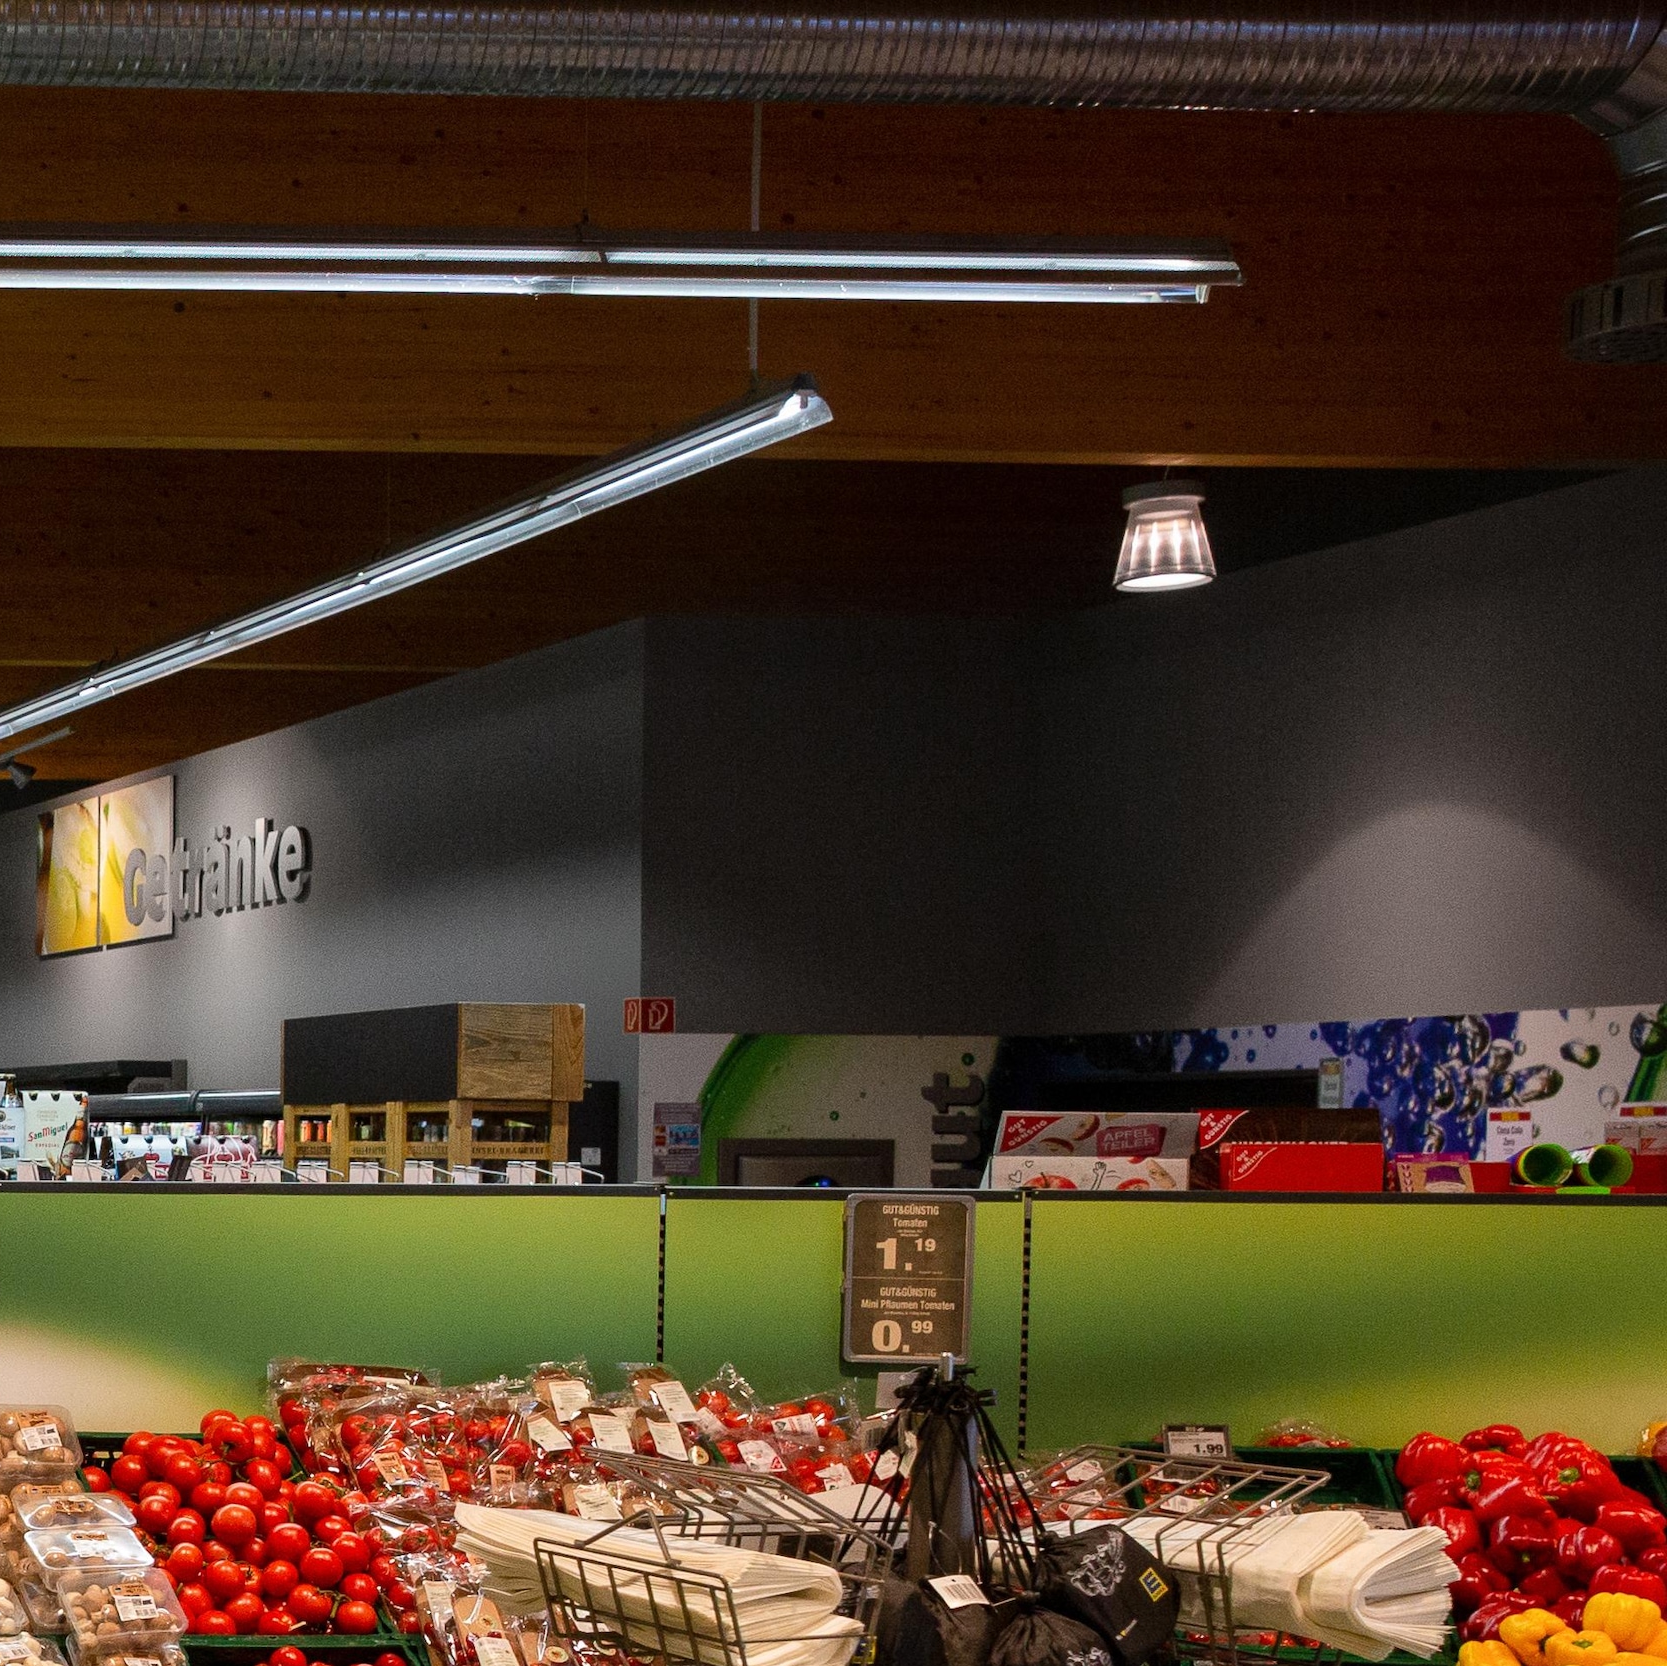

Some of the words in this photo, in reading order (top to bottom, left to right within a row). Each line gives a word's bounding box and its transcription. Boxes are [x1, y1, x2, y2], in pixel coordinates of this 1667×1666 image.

[123, 817, 313, 926] Getränke
[1008, 1117, 1026, 1133] GUT
[1199, 1112, 1215, 1128] GUT
[1103, 1127, 1153, 1143] APFEL
[1103, 1136, 1155, 1152] TEILER
[1235, 1148, 1250, 1163] GUT
[882, 1203, 940, 1215] GUT&GÜNSTIG
[893, 1218, 928, 1228] Tomaten
[879, 1286, 937, 1298] GUT&GÜNSTIG
[861, 1299, 879, 1309] Mini
[880, 1299, 919, 1310] Pflaumen
[920, 1300, 955, 1311] Tomaten
[1193, 1443, 1224, 1454] 1.99
